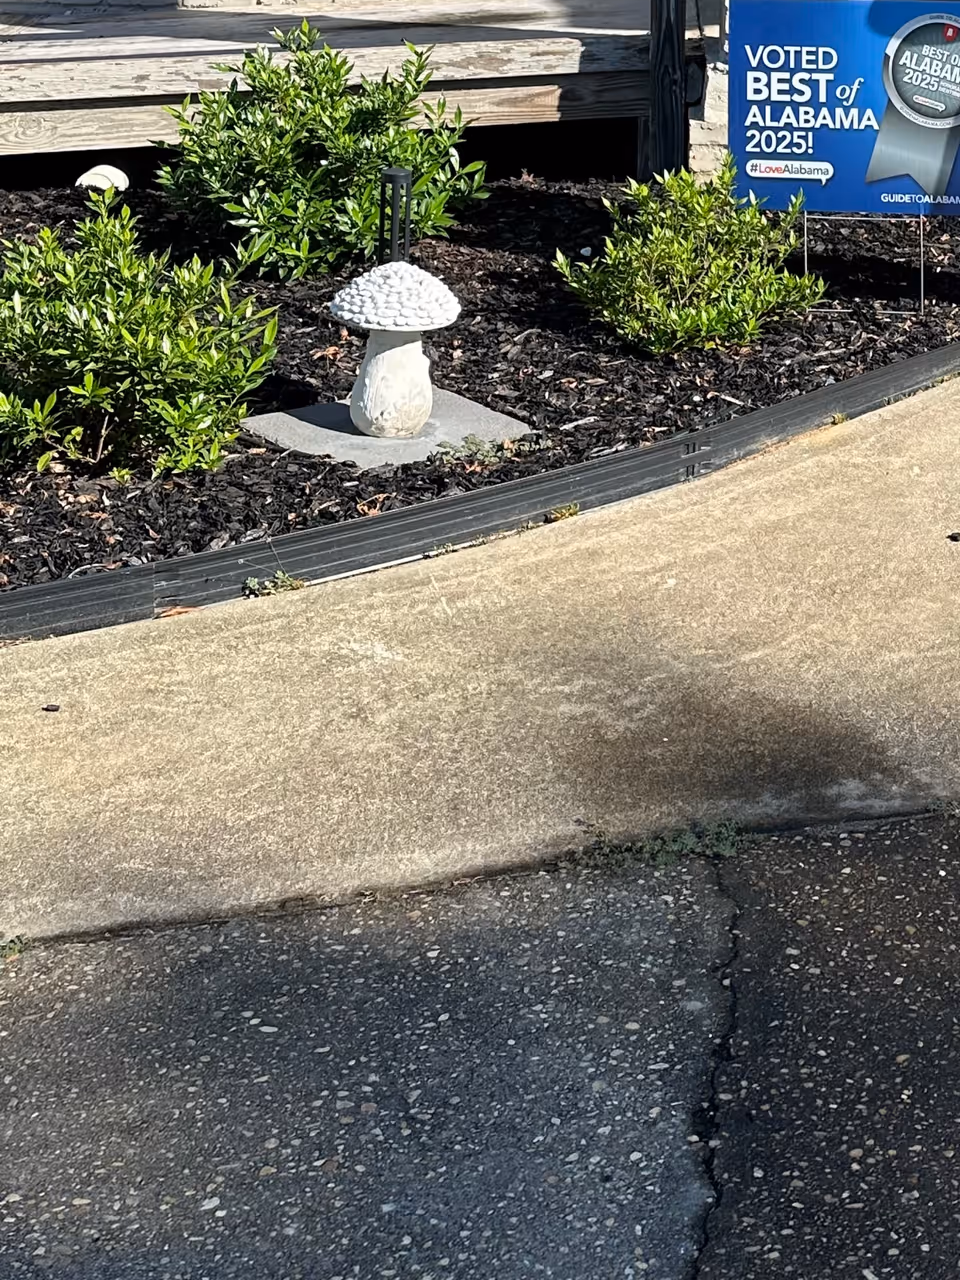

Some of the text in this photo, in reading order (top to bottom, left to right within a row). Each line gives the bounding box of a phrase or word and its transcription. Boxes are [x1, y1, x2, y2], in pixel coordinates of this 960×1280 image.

[744, 45, 838, 70] VOTED
[921, 44, 950, 62] BEST
[745, 71, 864, 106] BEST of
[902, 69, 940, 92] 2025
[744, 105, 880, 131] ALABAMA
[745, 130, 814, 154] 2025!
[750, 163, 830, 176] #LoveAlabama
